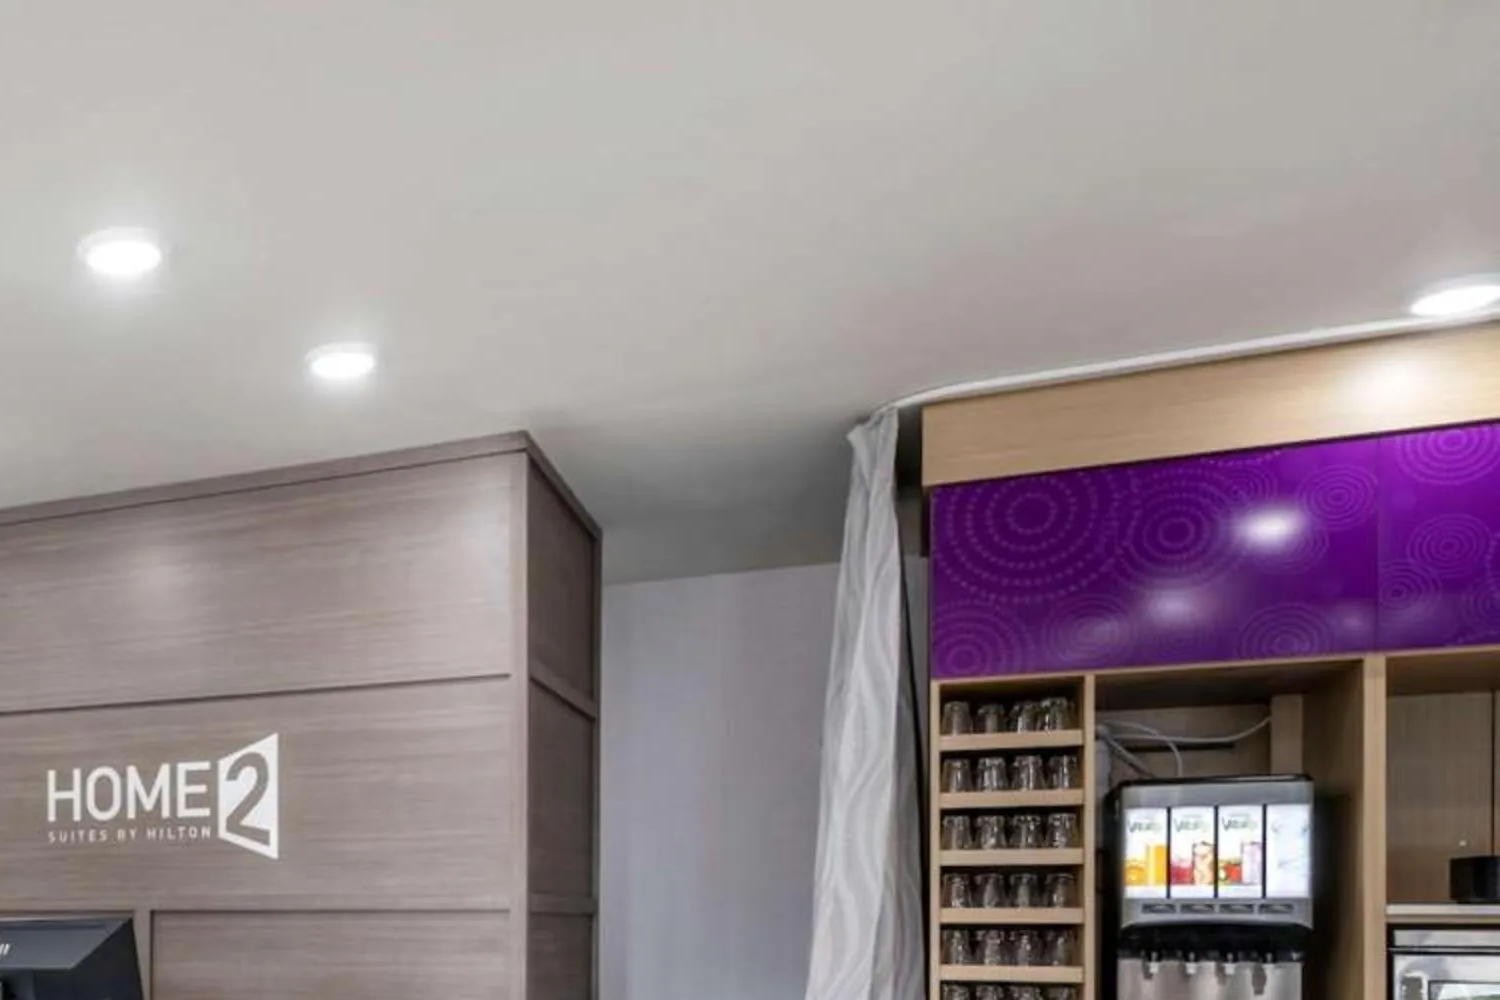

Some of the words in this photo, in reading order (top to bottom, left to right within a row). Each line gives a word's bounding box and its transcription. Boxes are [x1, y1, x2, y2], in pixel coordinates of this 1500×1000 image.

[47, 760, 211, 823] HOME
[223, 748, 273, 851] 2
[47, 828, 107, 844] SUITES
[117, 827, 137, 840] BY
[147, 825, 212, 841] HILTON
